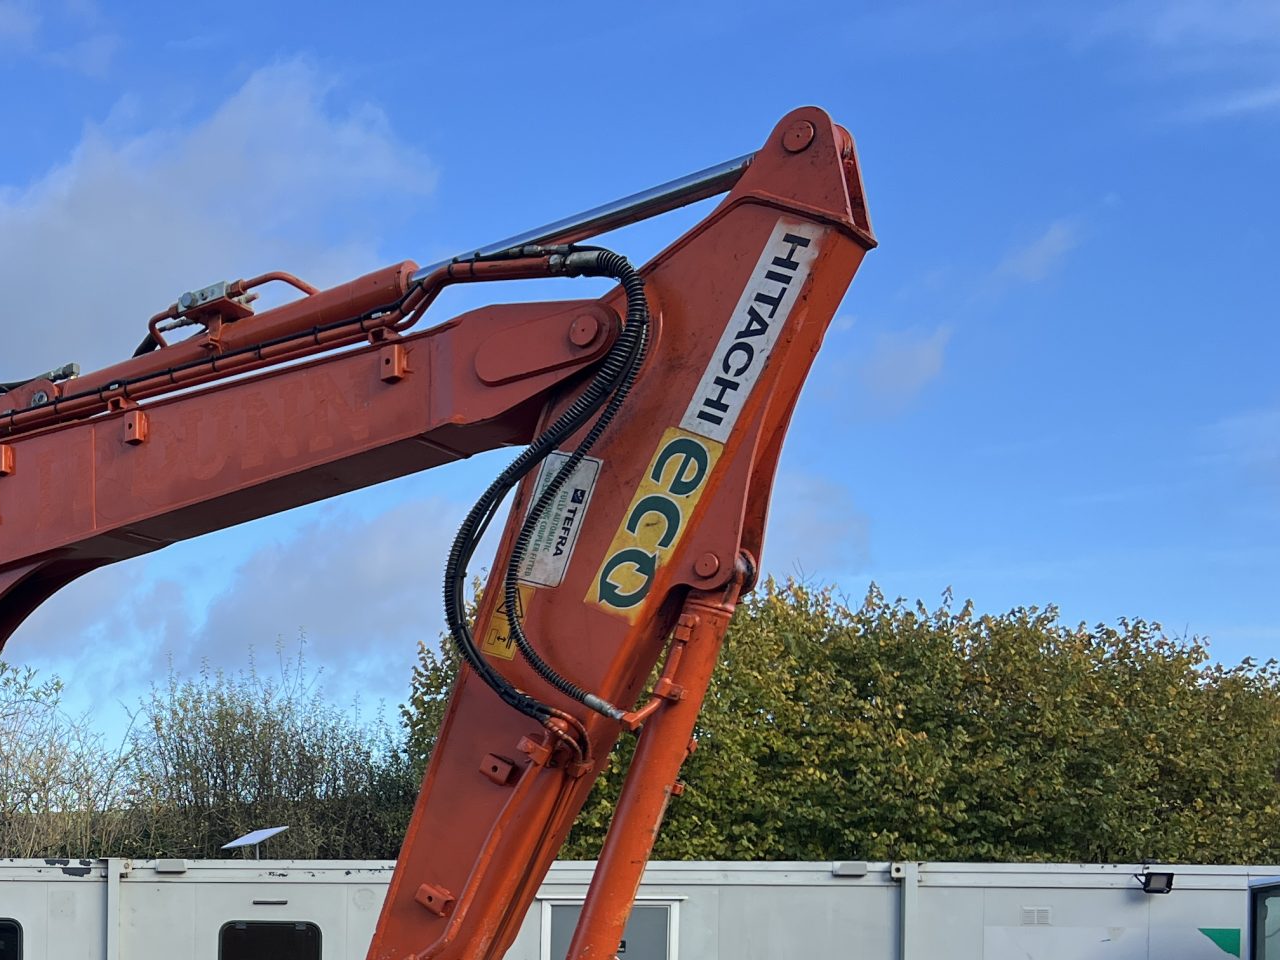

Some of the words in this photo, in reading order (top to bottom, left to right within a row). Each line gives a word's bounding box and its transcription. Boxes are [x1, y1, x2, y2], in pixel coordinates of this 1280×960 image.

[696, 232, 811, 426] HITACHI
[532, 520, 548, 552] COUPLER
[542, 511, 562, 553] AUTOMATIC
[552, 506, 578, 557] TEFRA
[598, 437, 709, 609] eco
[524, 553, 538, 577] FITTED
